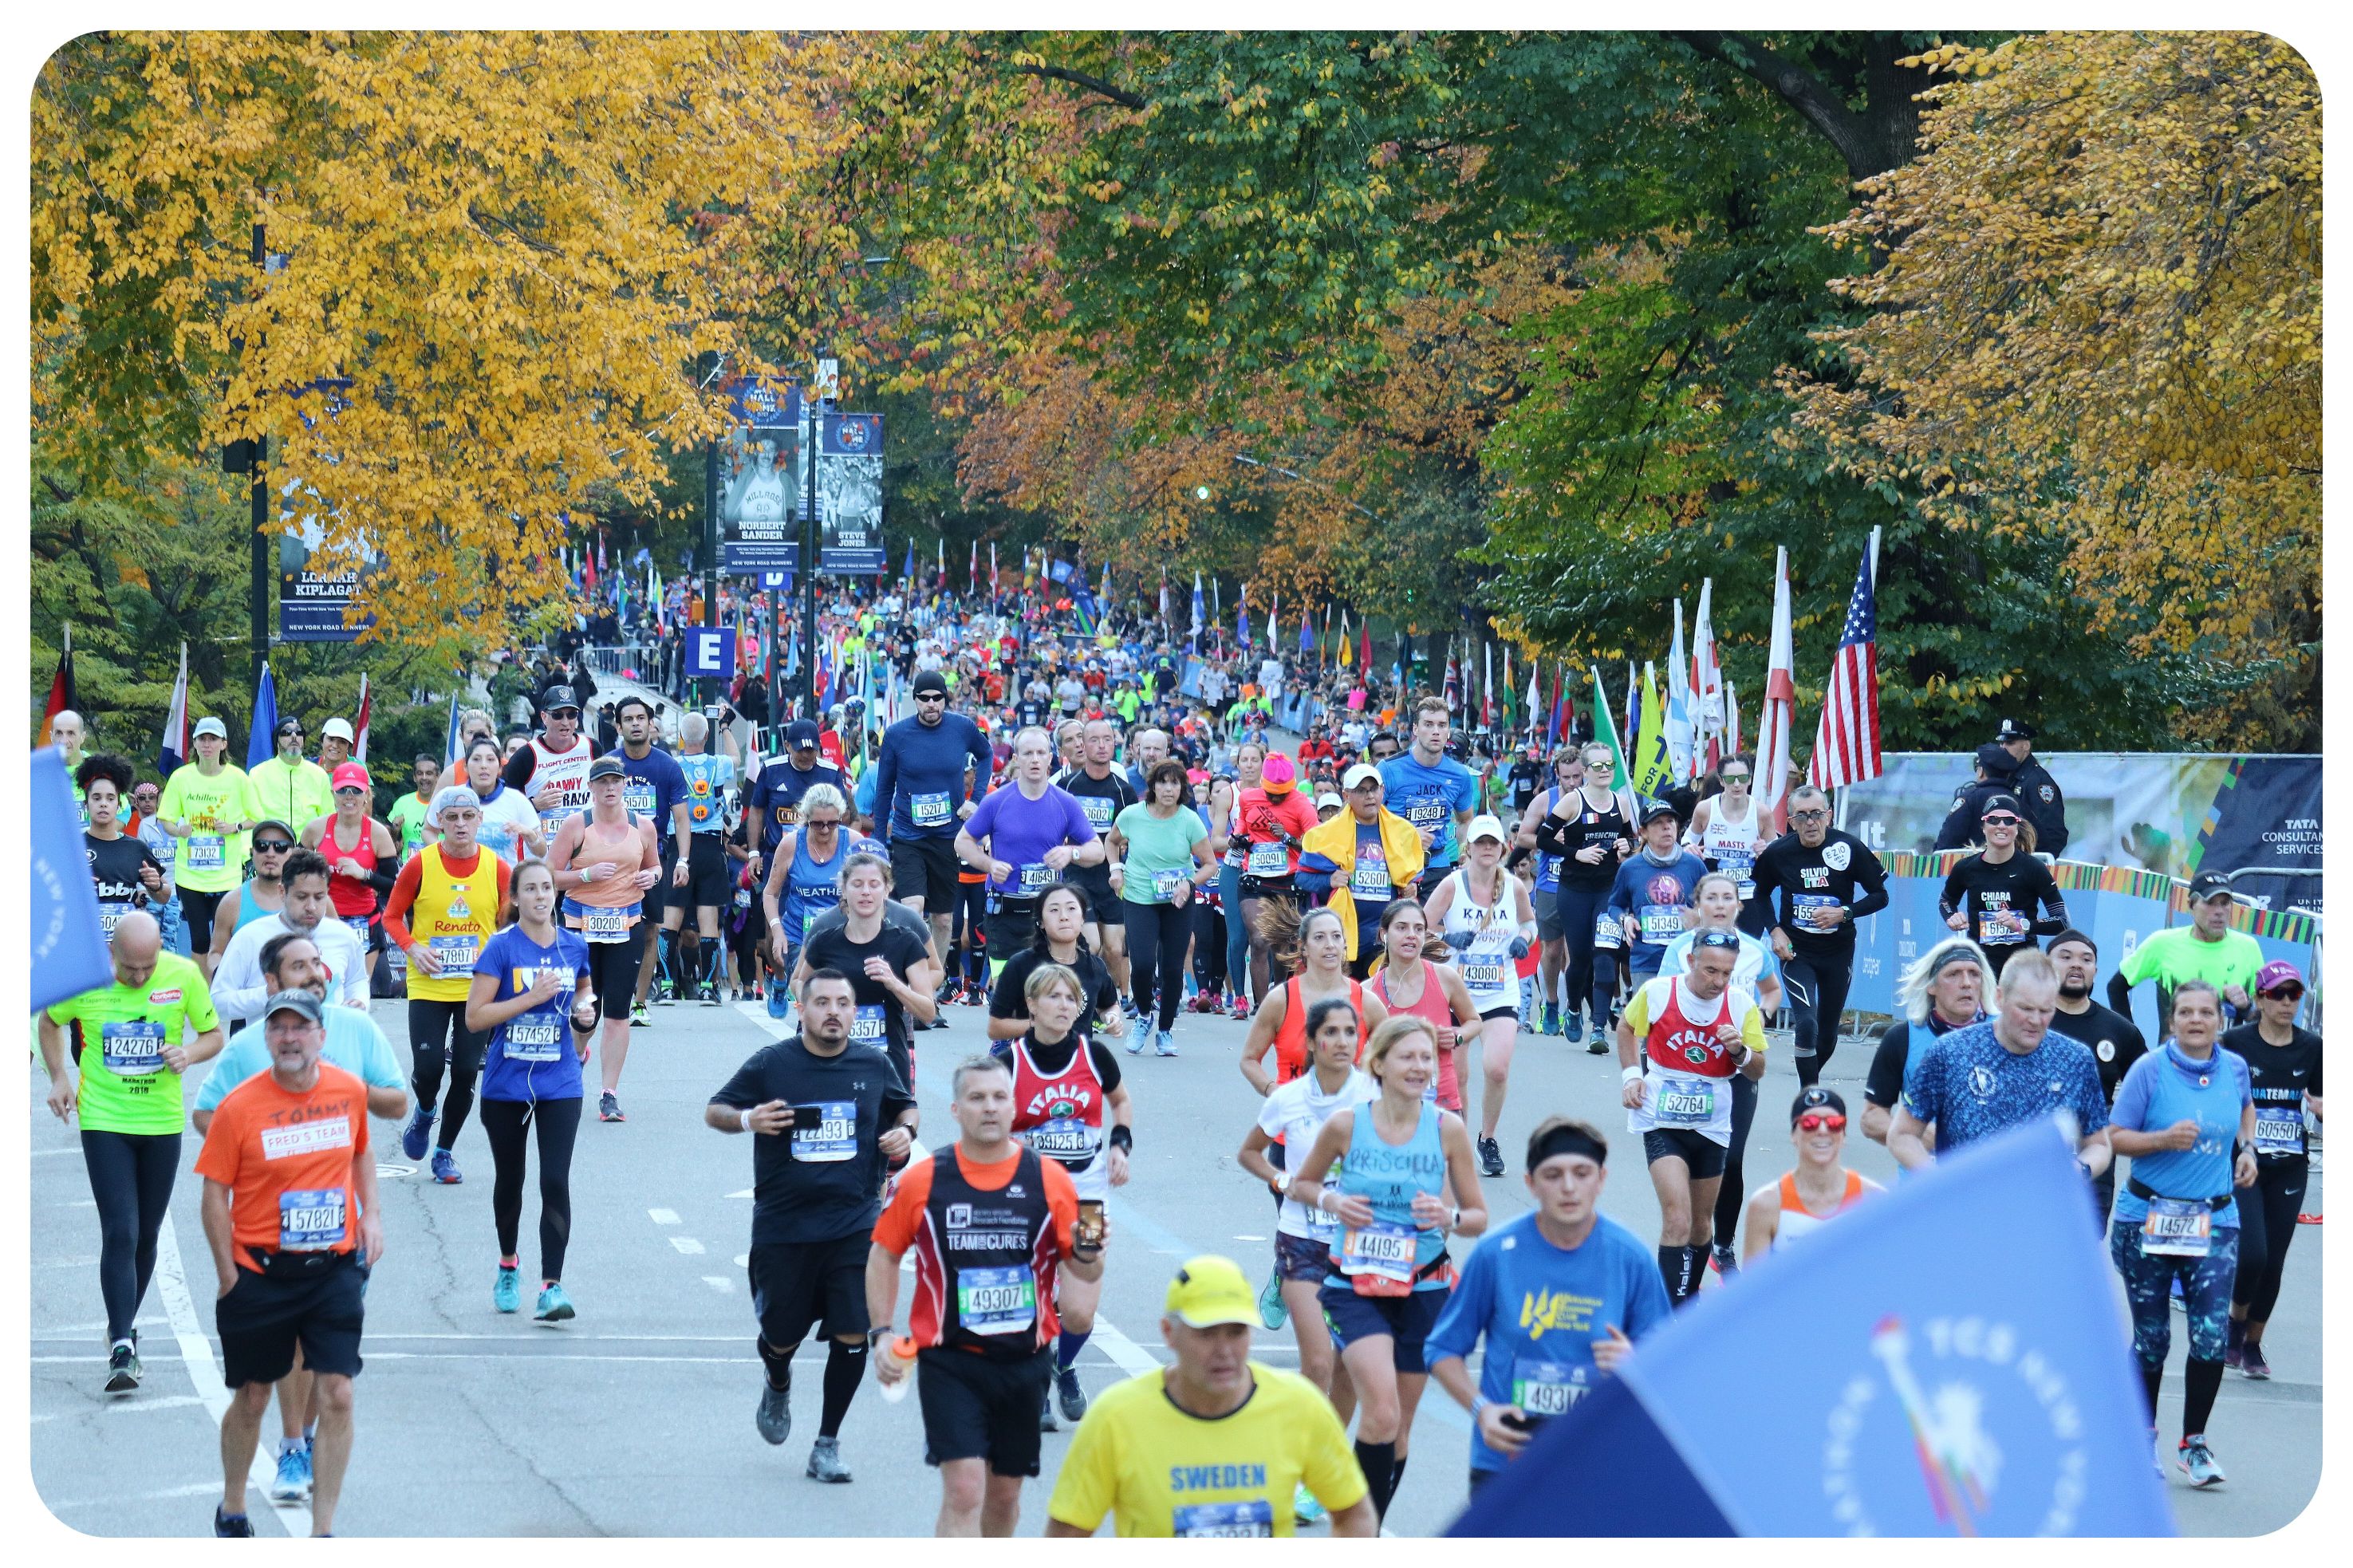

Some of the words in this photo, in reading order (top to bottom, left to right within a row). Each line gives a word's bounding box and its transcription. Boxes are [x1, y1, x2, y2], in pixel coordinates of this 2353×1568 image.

[739, 521, 786, 530] NORBERT
[741, 530, 783, 541] SANDER
[698, 633, 721, 670] E
[538, 760, 562, 770] FLIGHT
[562, 755, 588, 764] CENTRE
[546, 777, 583, 792] DANNY
[1640, 766, 1660, 793] FOR
[187, 793, 218, 802] Achilles
[1416, 784, 1443, 796] JACK
[921, 803, 941, 817] 15217
[1414, 807, 1437, 821] 19248
[2284, 818, 2319, 830] TATA
[1717, 840, 1745, 849] MASTS
[194, 846, 216, 859] 73132
[1255, 853, 1279, 865] 50091
[1826, 845, 1846, 860] EZIO
[34, 857, 64, 901] NEW
[1358, 872, 1385, 886] 52601
[1800, 866, 1829, 880] SILVIO
[1804, 877, 1830, 888] ITA
[98, 883, 136, 903] bby
[795, 886, 842, 897] HEATHE
[1981, 892, 2012, 902] CHIARA
[1985, 901, 2010, 911] ITA
[434, 920, 480, 932] Renato
[590, 916, 621, 930] 30209
[1651, 916, 1679, 931] 51349
[440, 948, 470, 964] 47807
[1464, 966, 1498, 981] 43080
[516, 1026, 550, 1043] 57452
[115, 1038, 154, 1056] 24276
[1665, 1029, 1726, 1060] ITALIA
[1027, 1083, 1090, 1117] ITALIA
[1667, 1096, 1704, 1113] 52764
[269, 1101, 350, 1125] TOMMY
[268, 1131, 312, 1148] FRED'S
[317, 1125, 346, 1140] TEAM
[2256, 1121, 2295, 1139] 60550
[296, 1206, 334, 1229] 57821
[2160, 1217, 2195, 1235] 14572
[946, 1234, 978, 1251] TEAM
[987, 1234, 1027, 1251] CURES
[1358, 1235, 1402, 1257] 44195
[972, 1286, 1021, 1311] 49307
[1925, 1316, 2016, 1364] TCS
[1170, 1464, 1267, 1492] SWEDEN
